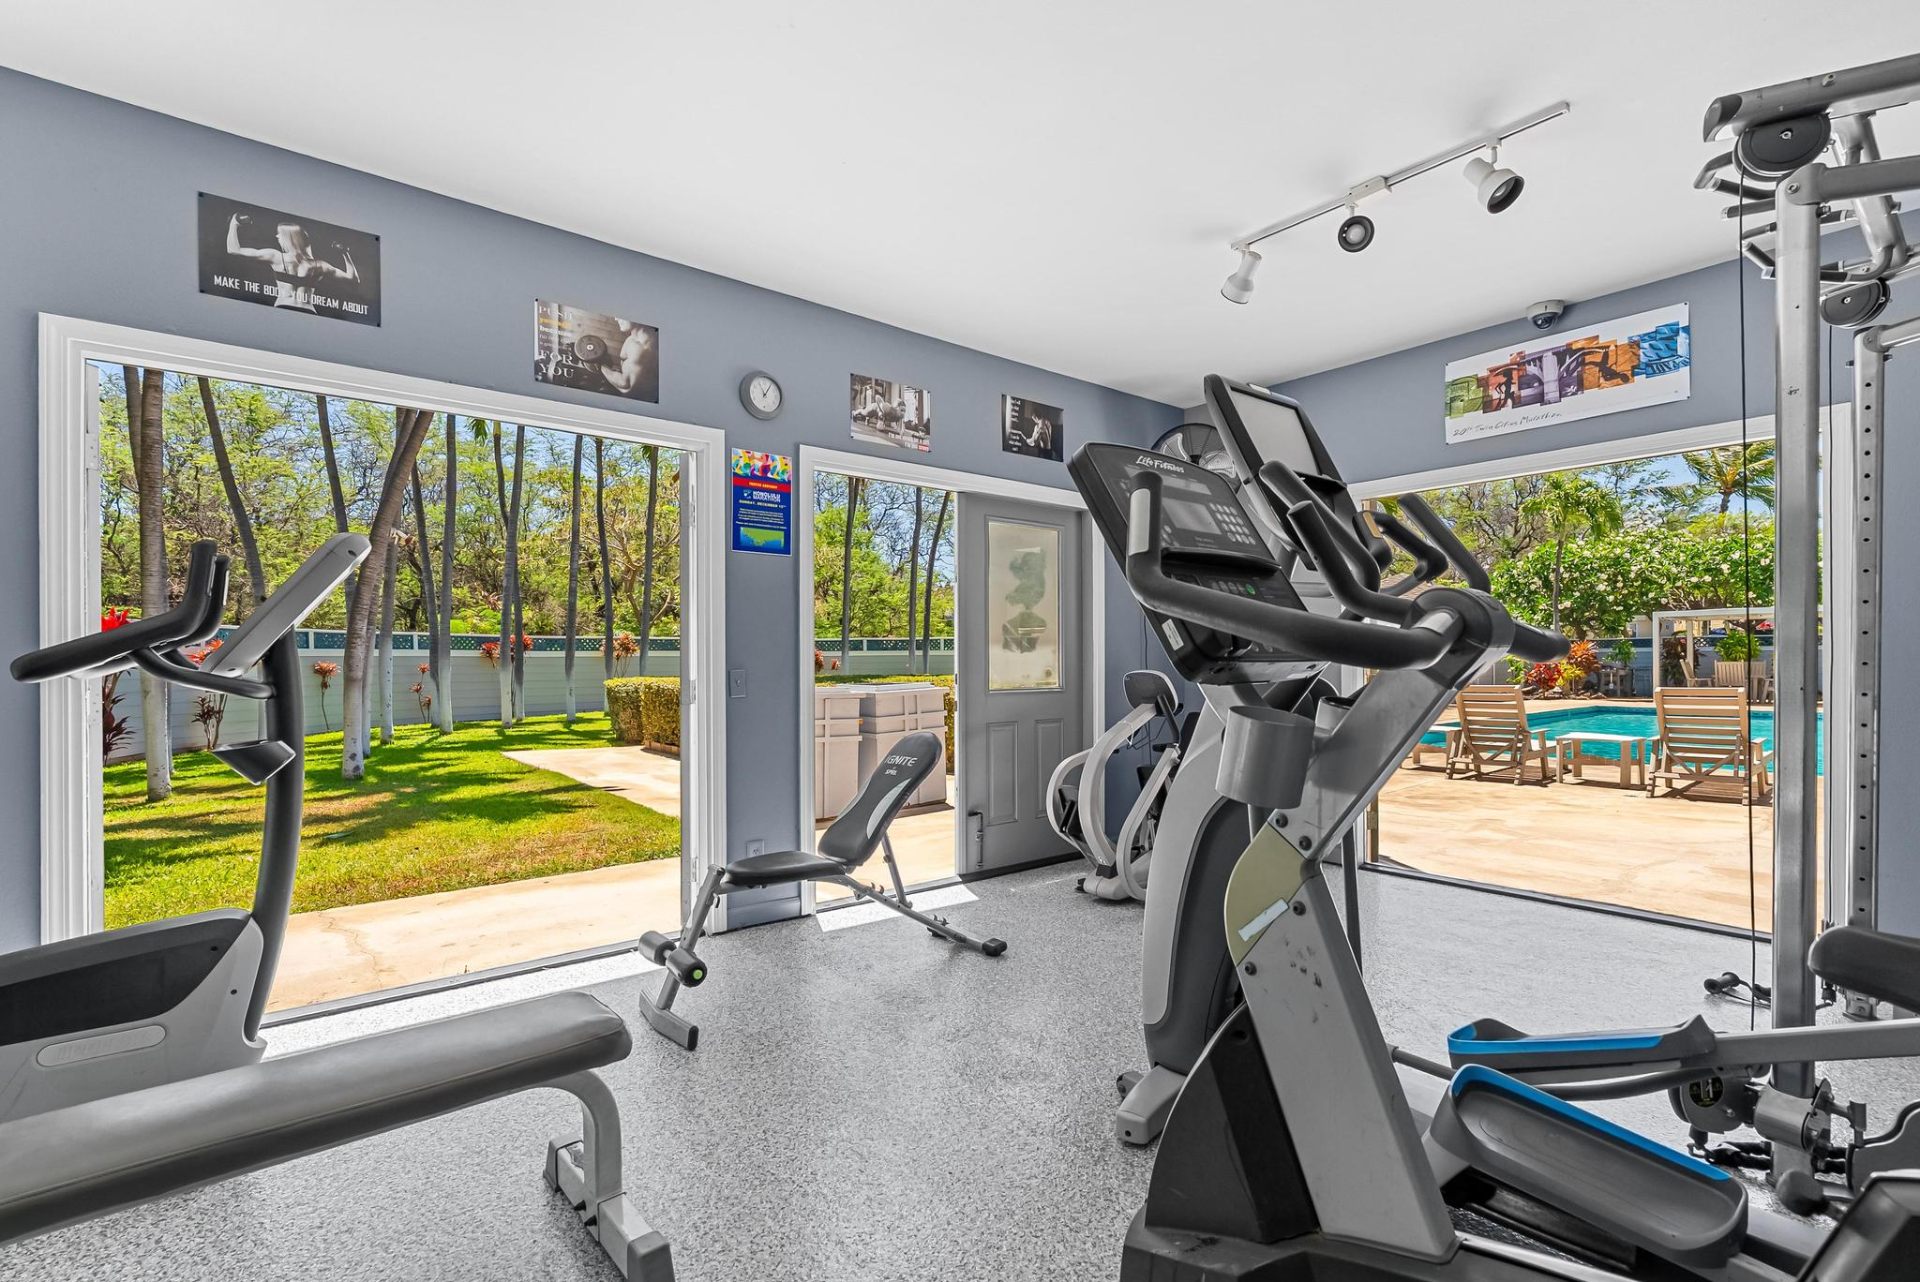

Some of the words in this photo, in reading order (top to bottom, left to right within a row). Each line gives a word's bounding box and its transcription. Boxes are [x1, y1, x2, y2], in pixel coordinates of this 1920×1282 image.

[214, 274, 240, 290] MAKE
[244, 280, 260, 294] THE
[263, 284, 286, 299] BOD
[311, 294, 339, 309] DREAM
[342, 301, 369, 315] ABOUT
[540, 363, 574, 378] YOU
[1136, 456, 1153, 467] Life
[884, 755, 918, 766] IGNITE
